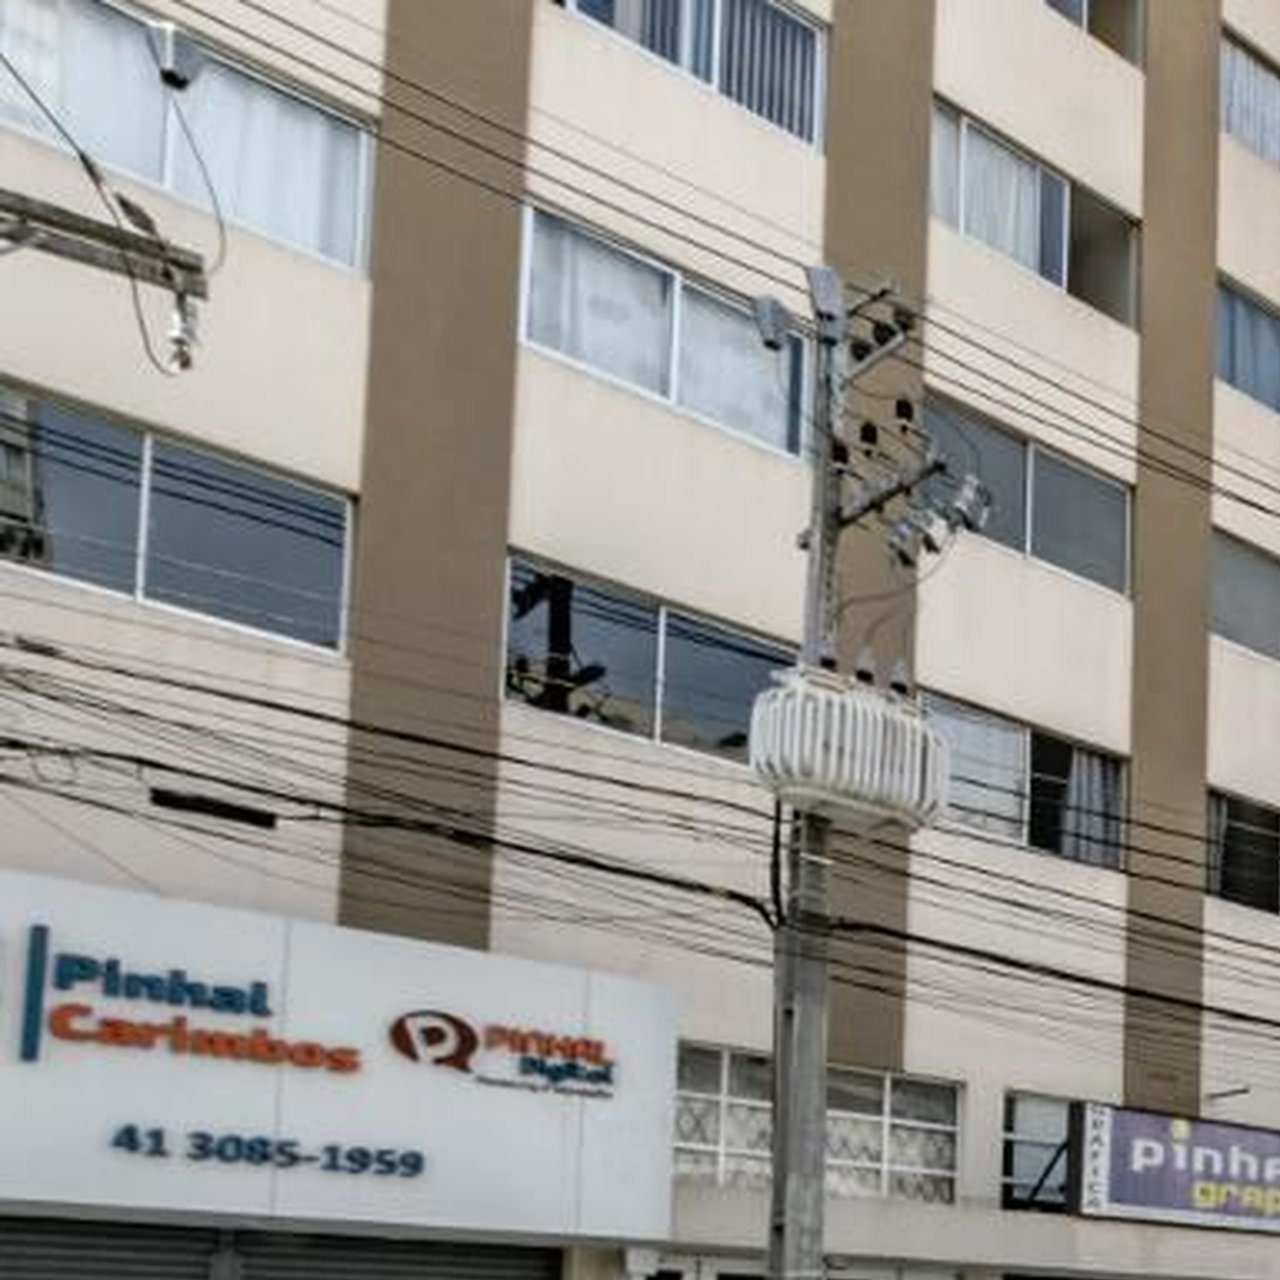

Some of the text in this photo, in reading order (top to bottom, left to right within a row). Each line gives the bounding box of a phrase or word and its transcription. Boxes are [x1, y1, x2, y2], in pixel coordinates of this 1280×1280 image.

[52, 952, 272, 1017] Pinhal
[48, 1003, 361, 1073] Carimbos
[110, 1123, 425, 1178] 41 3085-1959
